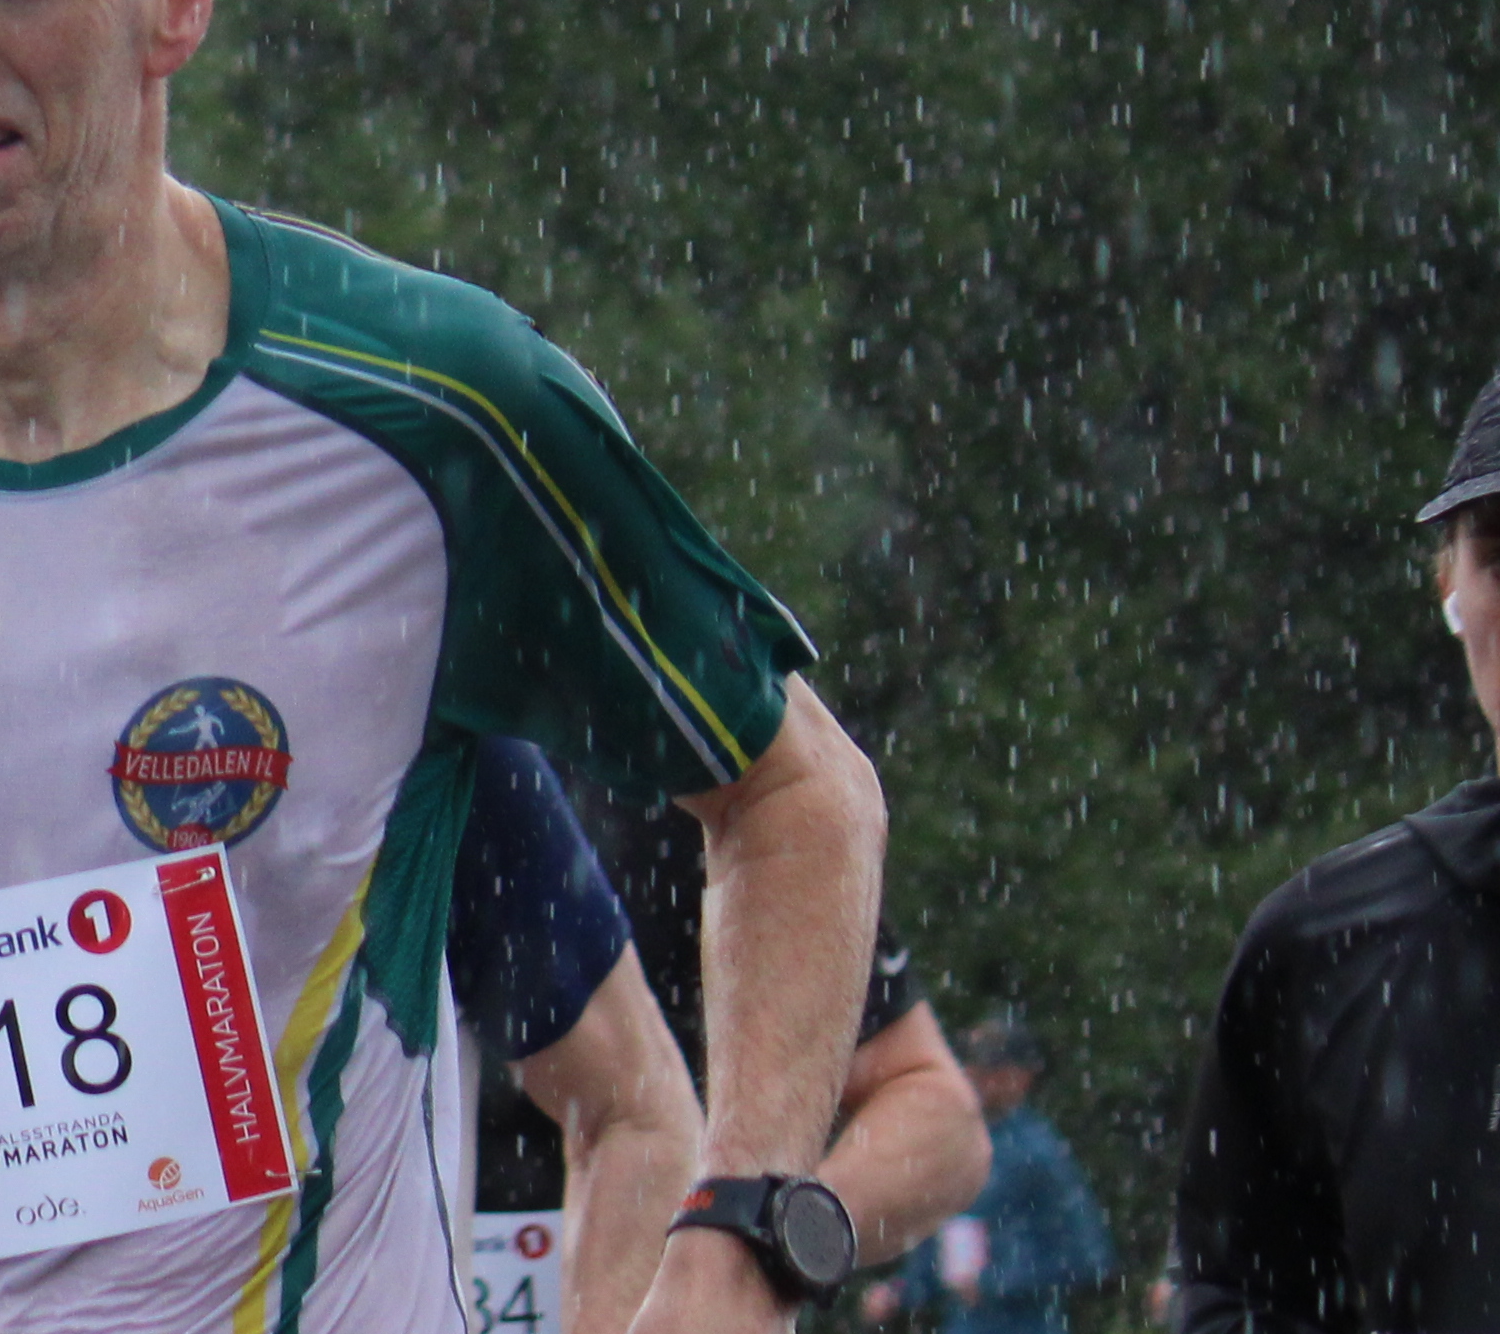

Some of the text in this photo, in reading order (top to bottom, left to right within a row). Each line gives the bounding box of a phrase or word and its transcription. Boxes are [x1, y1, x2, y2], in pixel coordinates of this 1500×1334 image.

[125, 750, 251, 780] VELLEDALEN
[187, 911, 261, 1144] HALVMARATON
[137, 1186, 205, 1213] AquaGen
